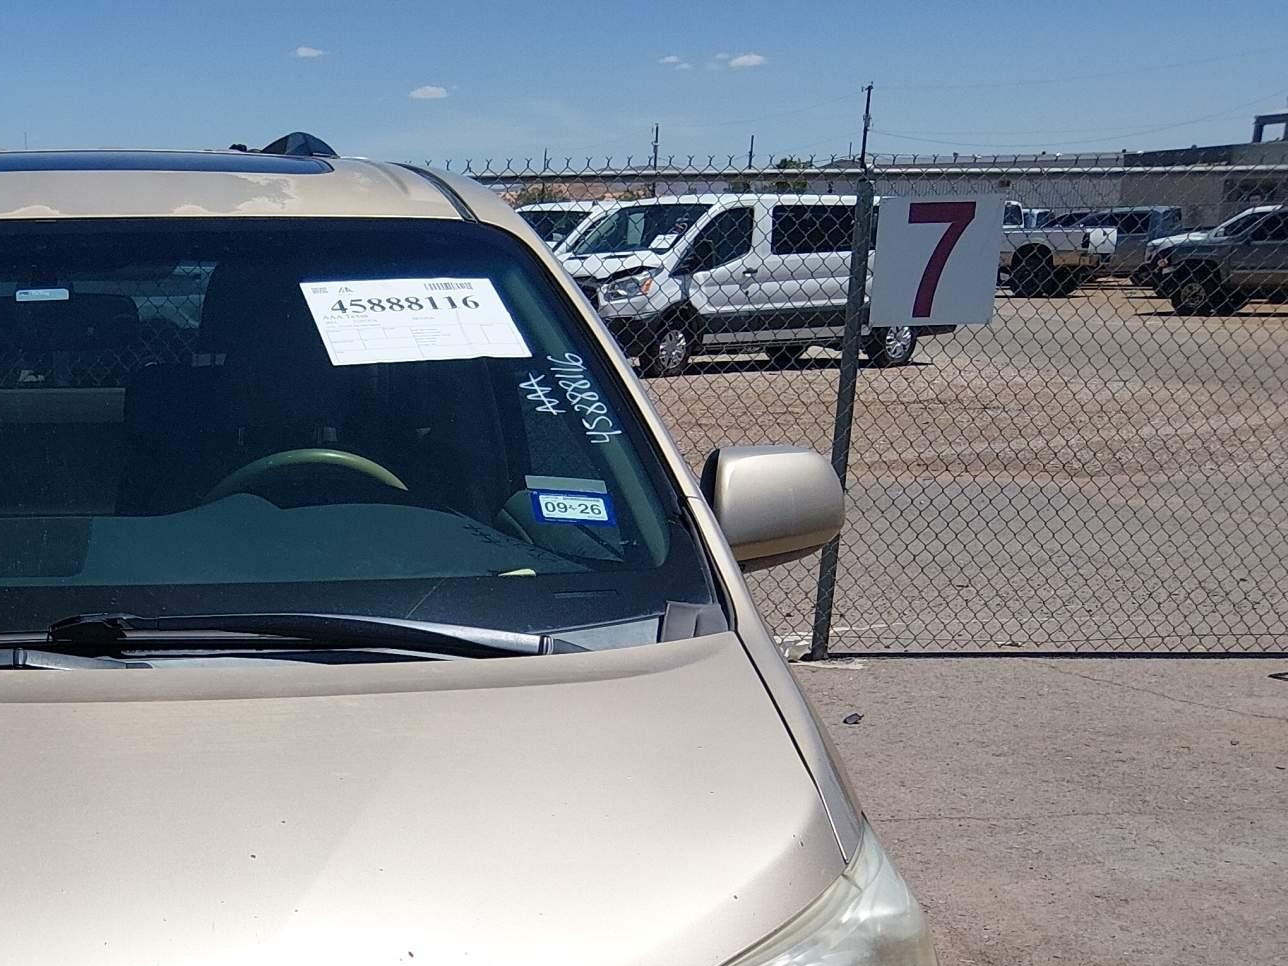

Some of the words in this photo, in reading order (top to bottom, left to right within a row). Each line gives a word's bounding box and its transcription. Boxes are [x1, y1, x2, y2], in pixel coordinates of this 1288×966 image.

[330, 295, 481, 314] 45888116
[907, 201, 976, 319] 7
[546, 353, 622, 443] 45888116
